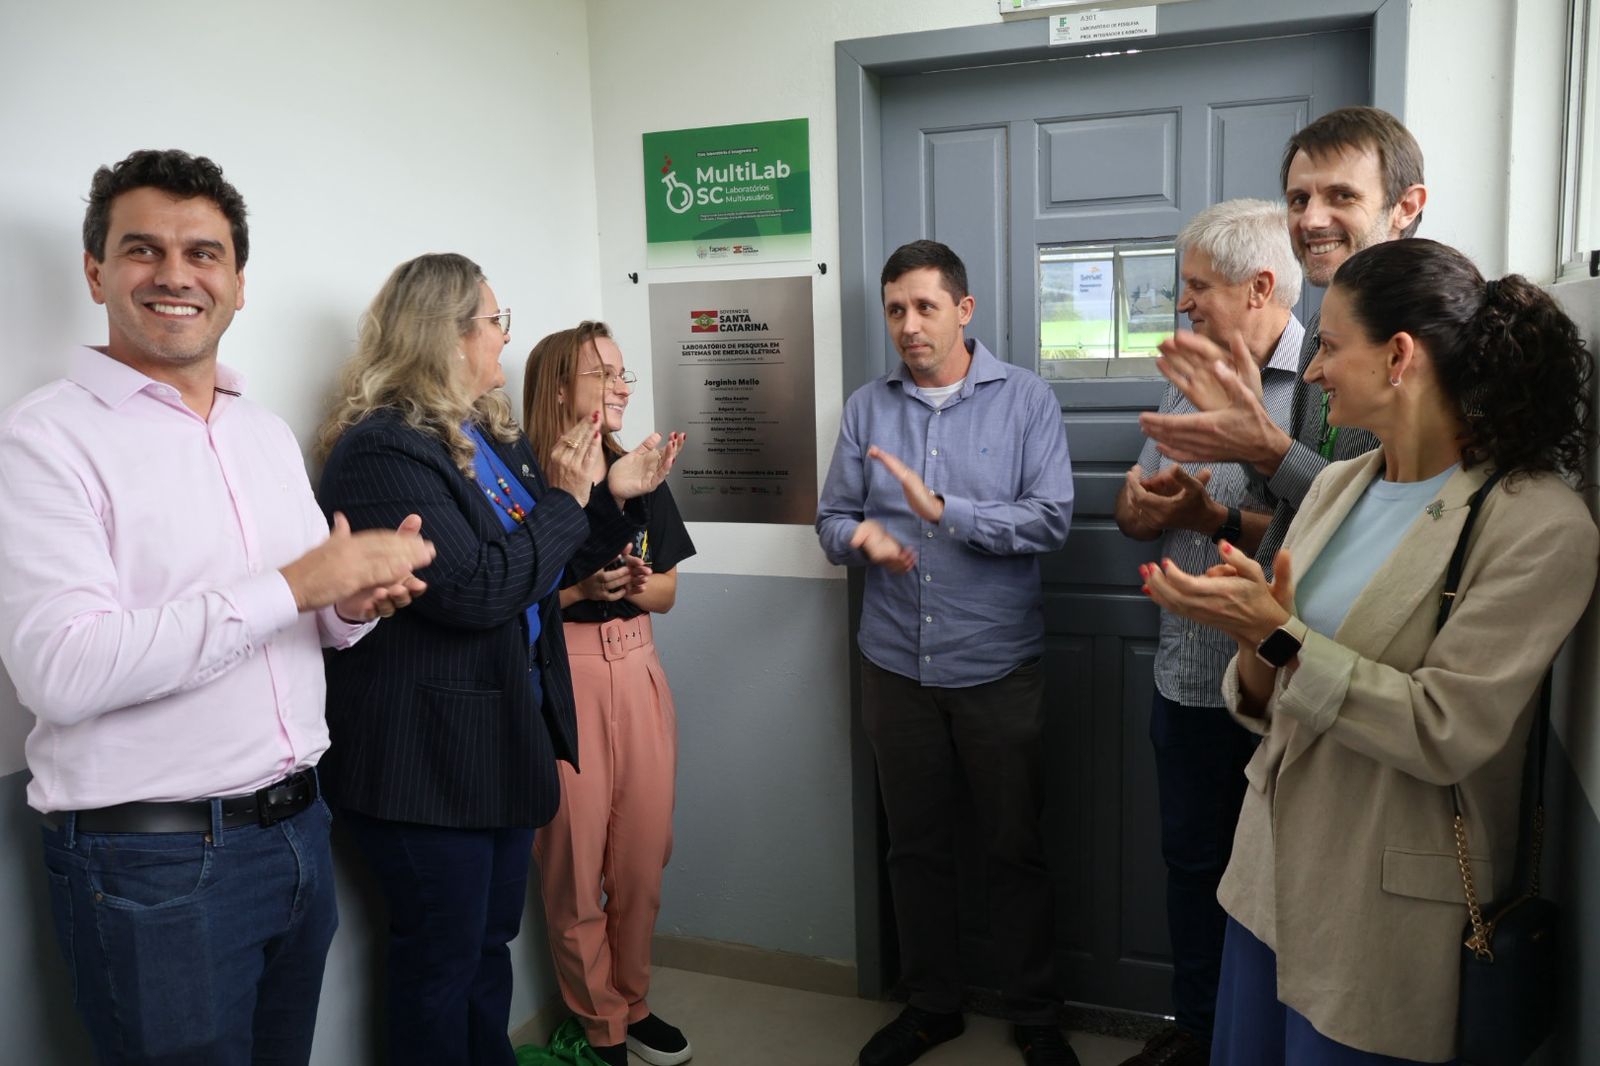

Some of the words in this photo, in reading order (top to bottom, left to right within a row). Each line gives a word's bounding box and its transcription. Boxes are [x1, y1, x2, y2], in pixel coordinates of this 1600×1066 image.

[696, 160, 791, 184] MultiLab
[725, 184, 770, 194] Laboratórios
[696, 186, 724, 205] SC
[725, 192, 774, 203] Multiusuários
[719, 314, 751, 323] SANTA
[719, 323, 769, 332] CATARINA
[704, 379, 737, 387] Jorginho
[738, 378, 760, 386] Mello
